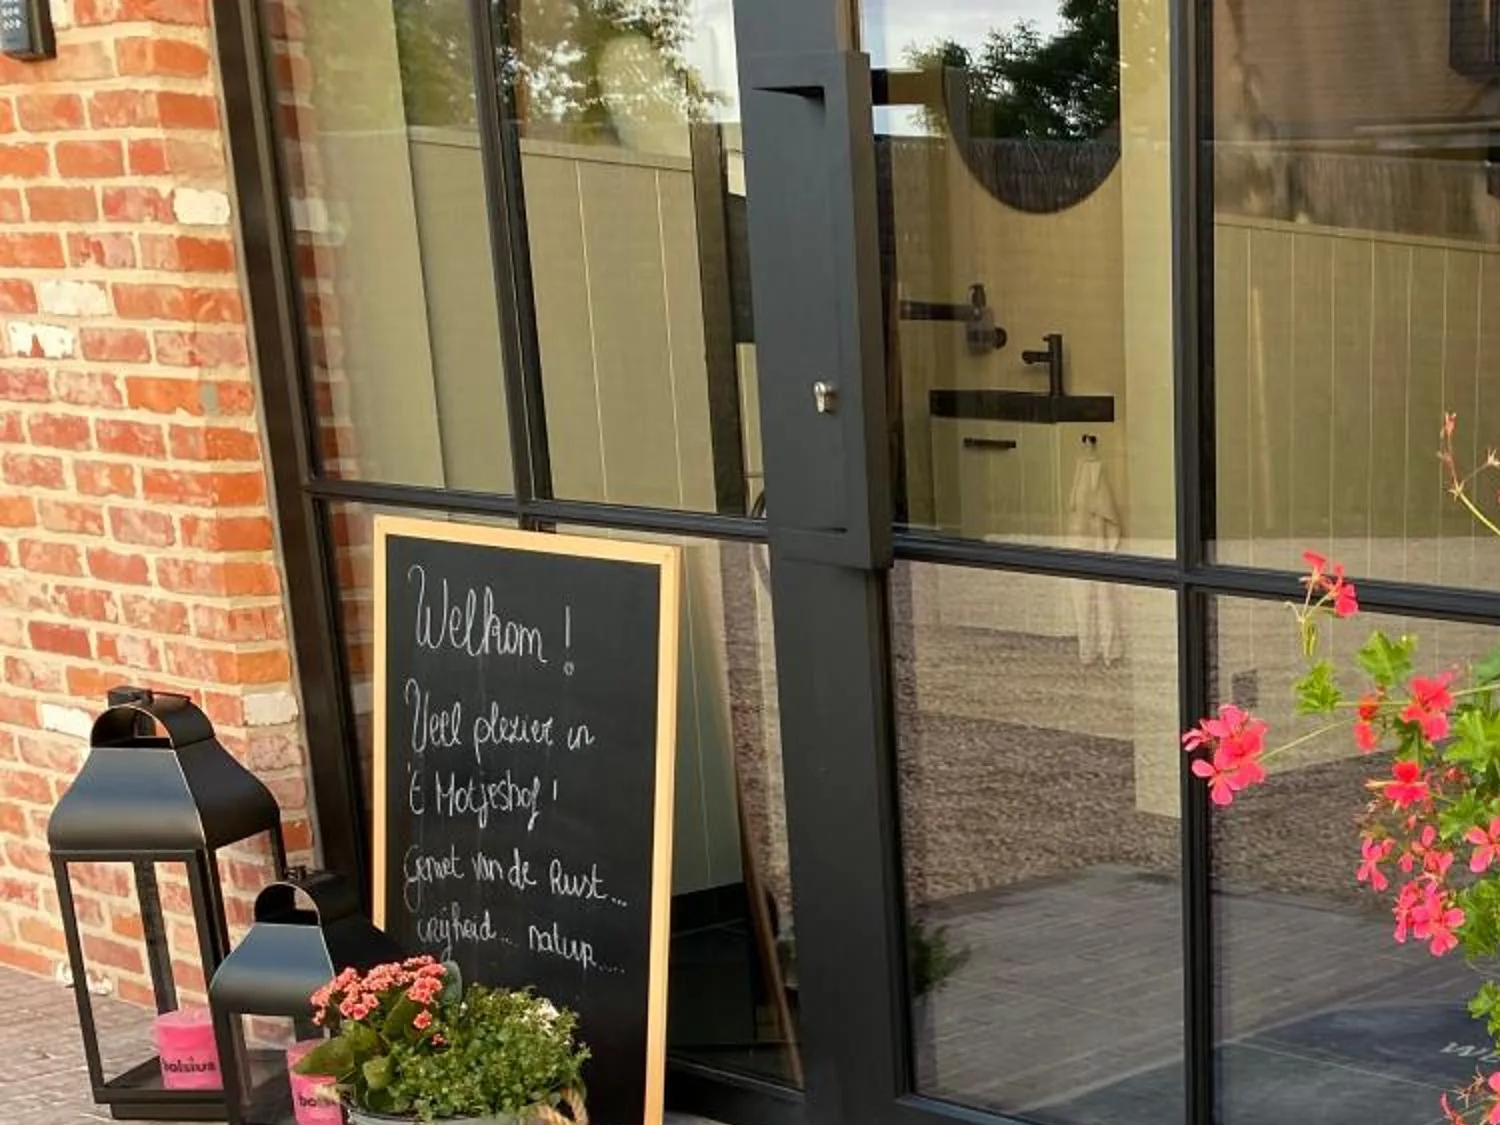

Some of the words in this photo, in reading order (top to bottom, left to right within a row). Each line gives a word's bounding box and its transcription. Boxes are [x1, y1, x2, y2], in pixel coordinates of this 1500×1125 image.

[407, 564, 548, 664] Welkom
[405, 678, 462, 753] Veel
[473, 701, 554, 765] plezier
[567, 725, 596, 750] in
[471, 852, 504, 881] van
[507, 848, 537, 890] de
